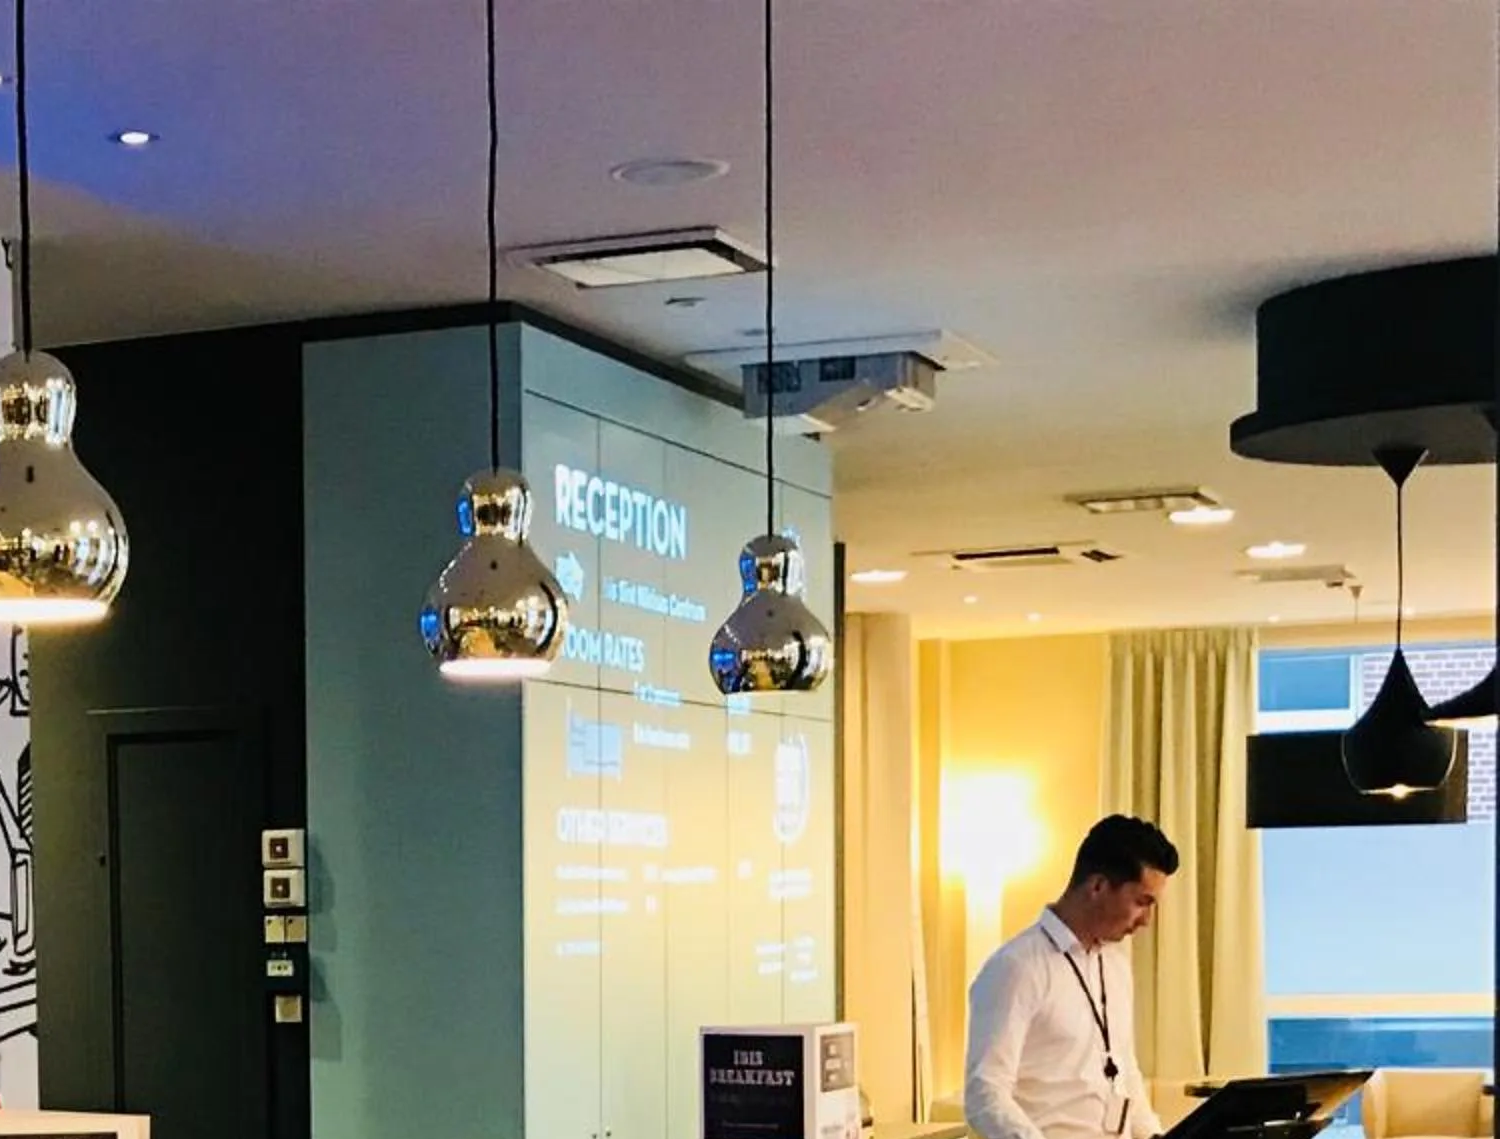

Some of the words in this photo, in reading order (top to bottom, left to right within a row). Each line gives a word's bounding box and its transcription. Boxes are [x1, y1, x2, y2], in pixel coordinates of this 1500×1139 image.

[555, 463, 687, 561] RECEPTION
[563, 623, 603, 664] OOM
[603, 632, 645, 674] RATES
[709, 1068, 796, 1087] BREAKFAST
